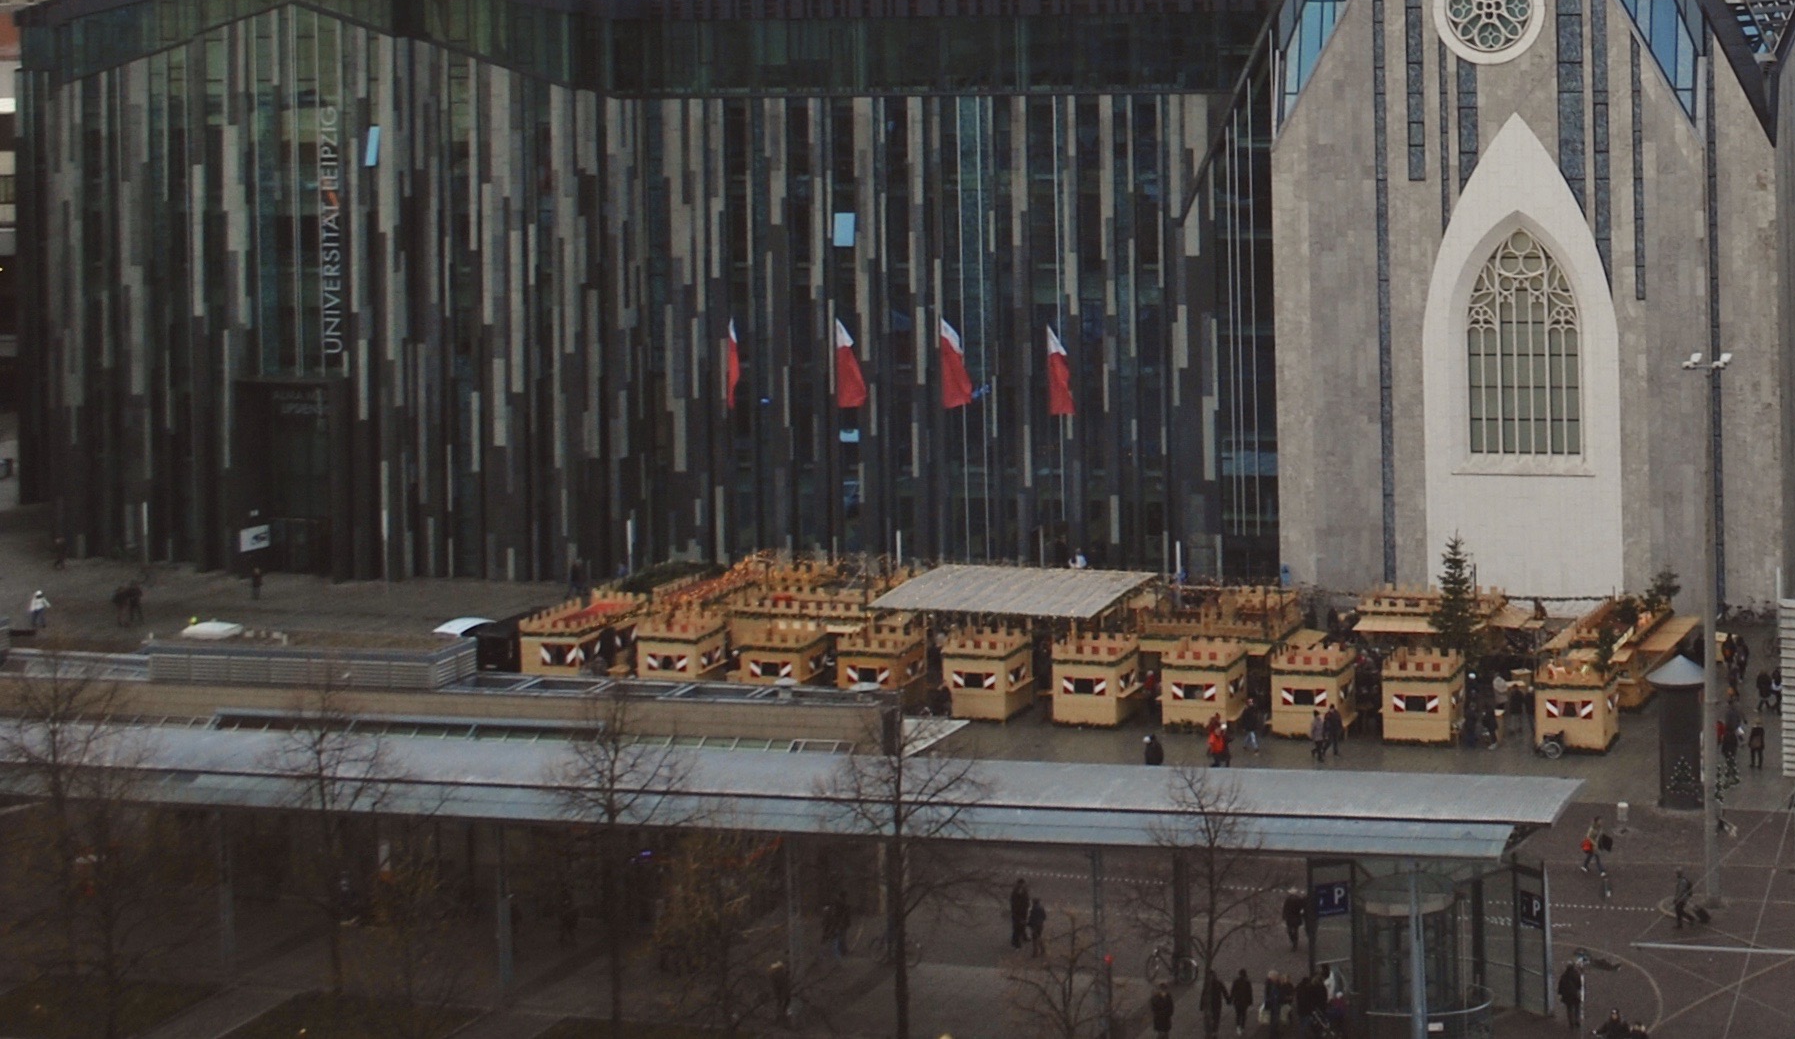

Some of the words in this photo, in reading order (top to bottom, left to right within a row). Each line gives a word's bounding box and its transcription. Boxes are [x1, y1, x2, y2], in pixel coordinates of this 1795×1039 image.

[319, 106, 339, 191] LEIPZIG
[1334, 886, 1346, 905] P
[1532, 899, 1541, 917] P
